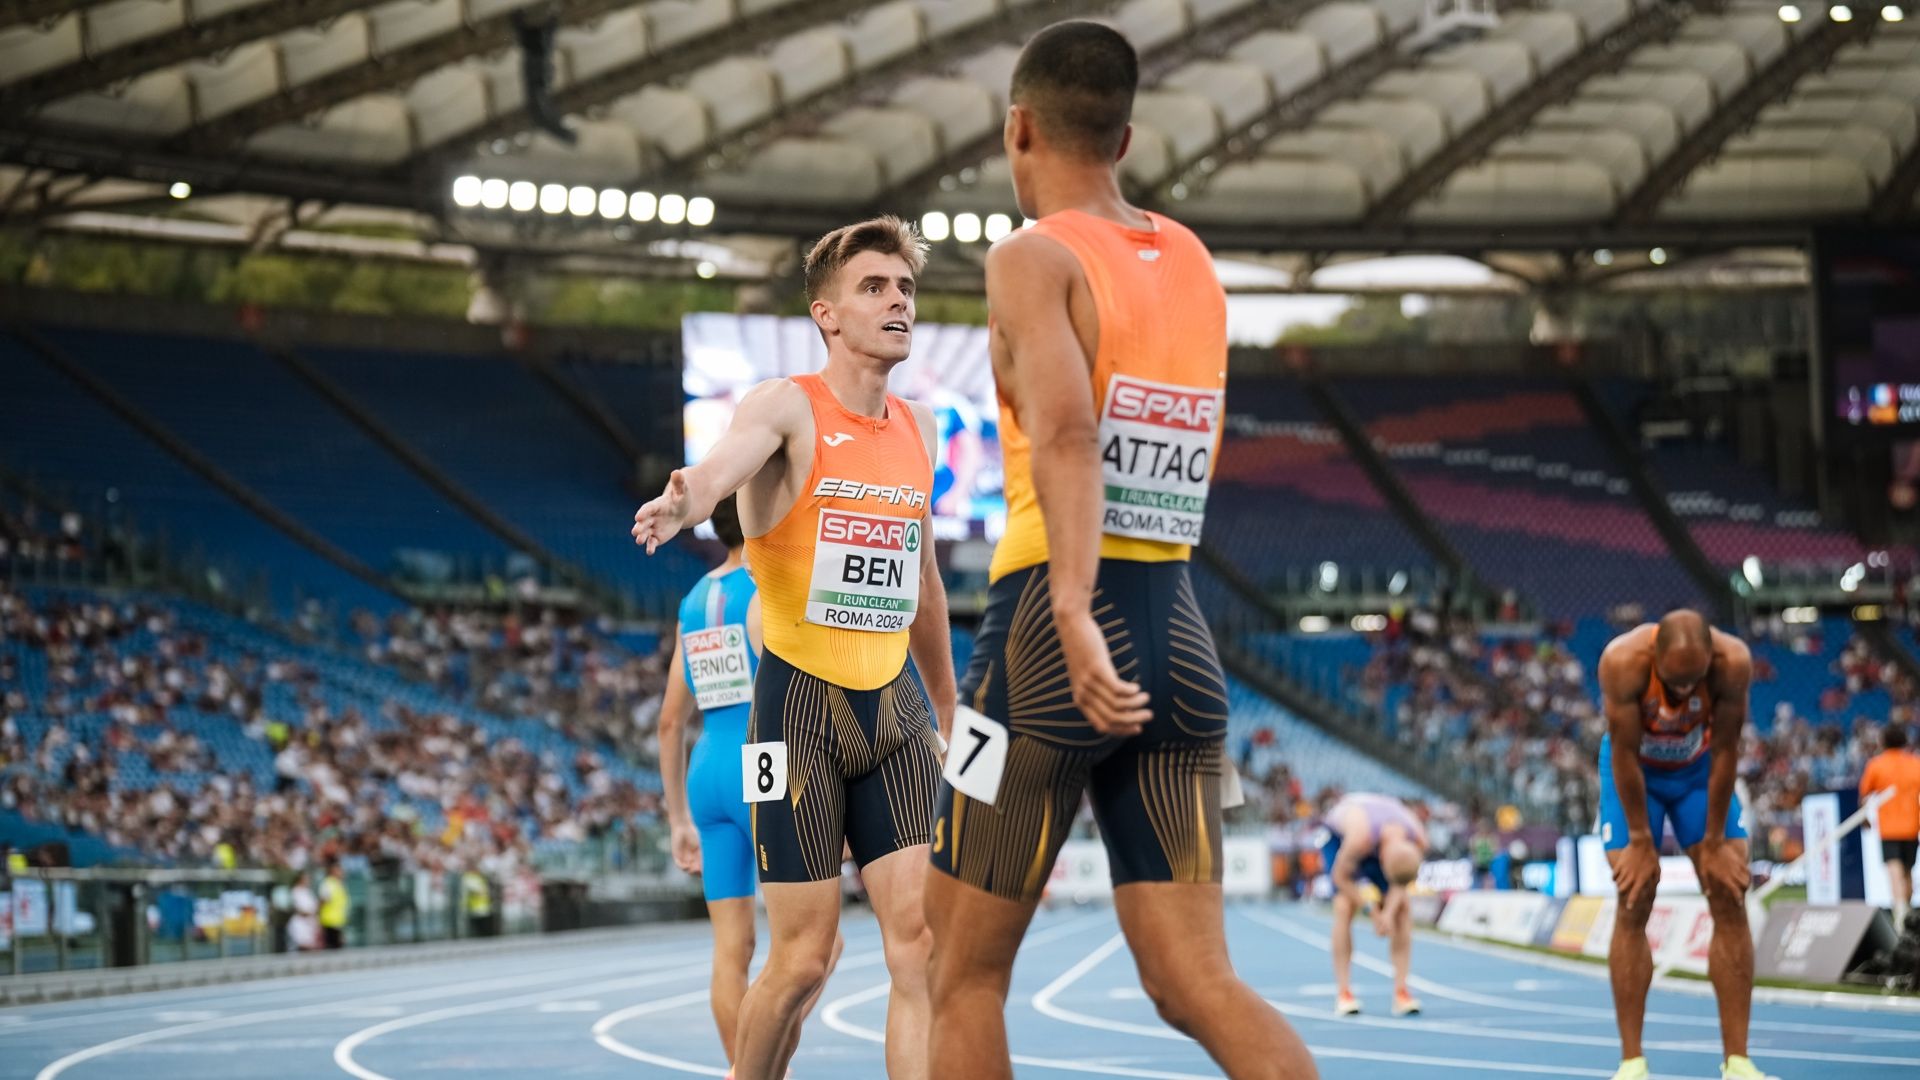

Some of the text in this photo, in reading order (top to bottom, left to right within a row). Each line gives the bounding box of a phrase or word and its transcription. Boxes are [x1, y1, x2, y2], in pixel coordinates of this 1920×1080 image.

[1112, 385, 1214, 428] SPAR
[813, 477, 927, 510] ESPAÑA
[1127, 489, 1158, 506] RUN
[823, 517, 904, 546] SPAR
[1103, 508, 1165, 533] ROMA
[842, 553, 904, 588] BEN
[843, 594, 867, 607] RUN
[825, 608, 904, 629] ROMA 2024
[959, 726, 991, 777] 7
[757, 752, 775, 794] 8
